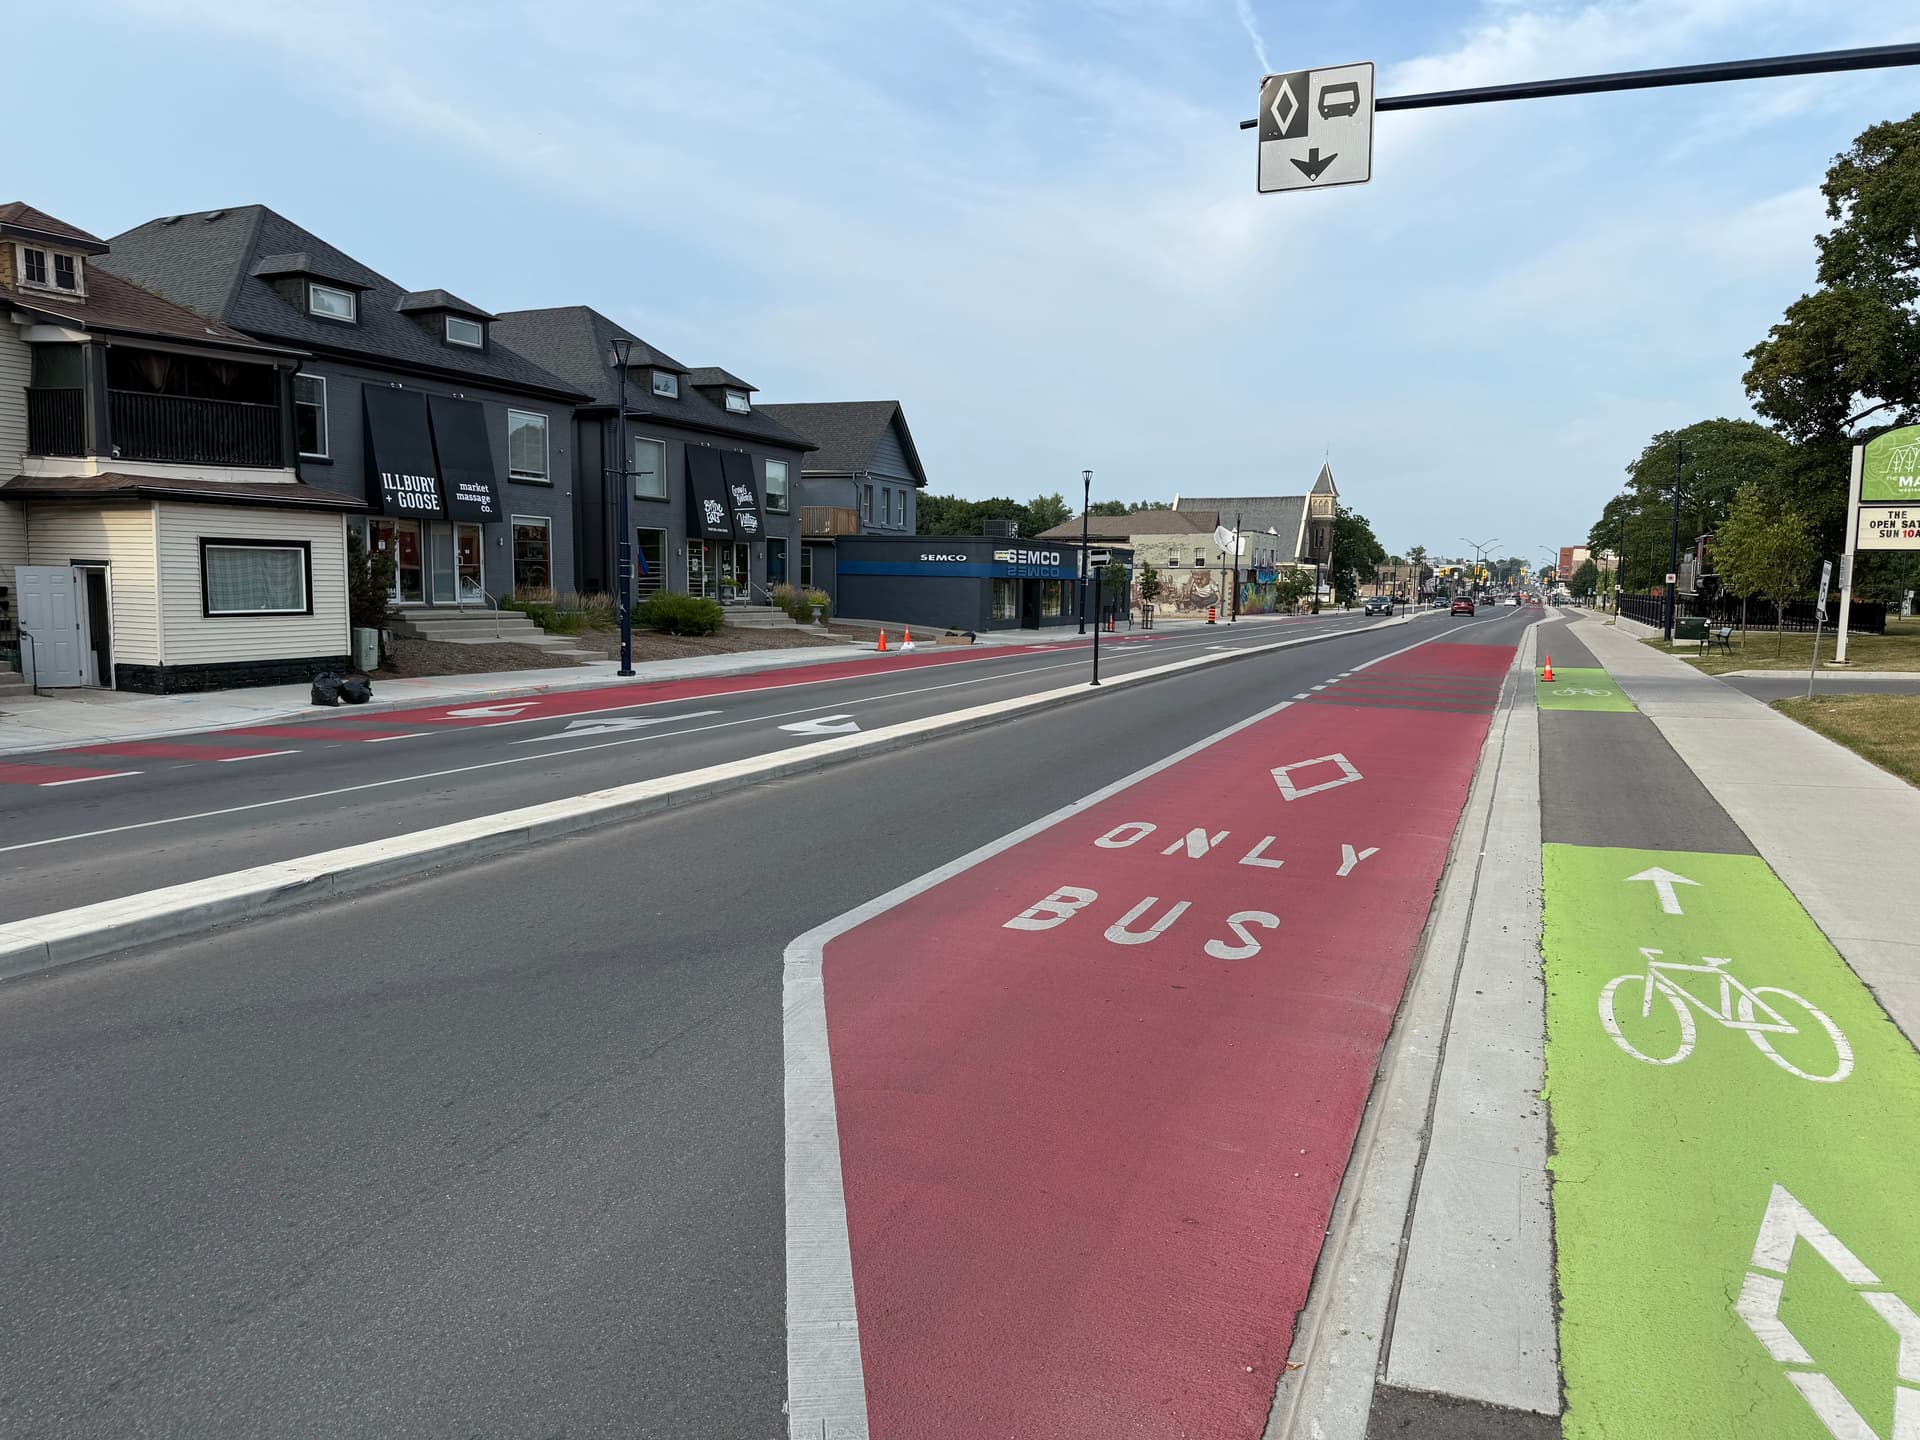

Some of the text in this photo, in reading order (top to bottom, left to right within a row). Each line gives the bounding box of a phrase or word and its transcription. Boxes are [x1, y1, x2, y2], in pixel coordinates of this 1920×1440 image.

[381, 472, 435, 493] ILLBURY
[459, 482, 489, 493] market
[386, 491, 440, 510] + GOOSE
[456, 493, 491, 505] massage
[480, 505, 493, 513] co.
[1888, 511, 1907, 519] THE
[1870, 520, 1896, 529] OPEN
[1879, 530, 1899, 538] SUN
[920, 553, 967, 562] SEMCO
[1007, 549, 1060, 566] SEMCO
[1093, 821, 1381, 877] ONLY
[1001, 885, 1281, 961] BUS
